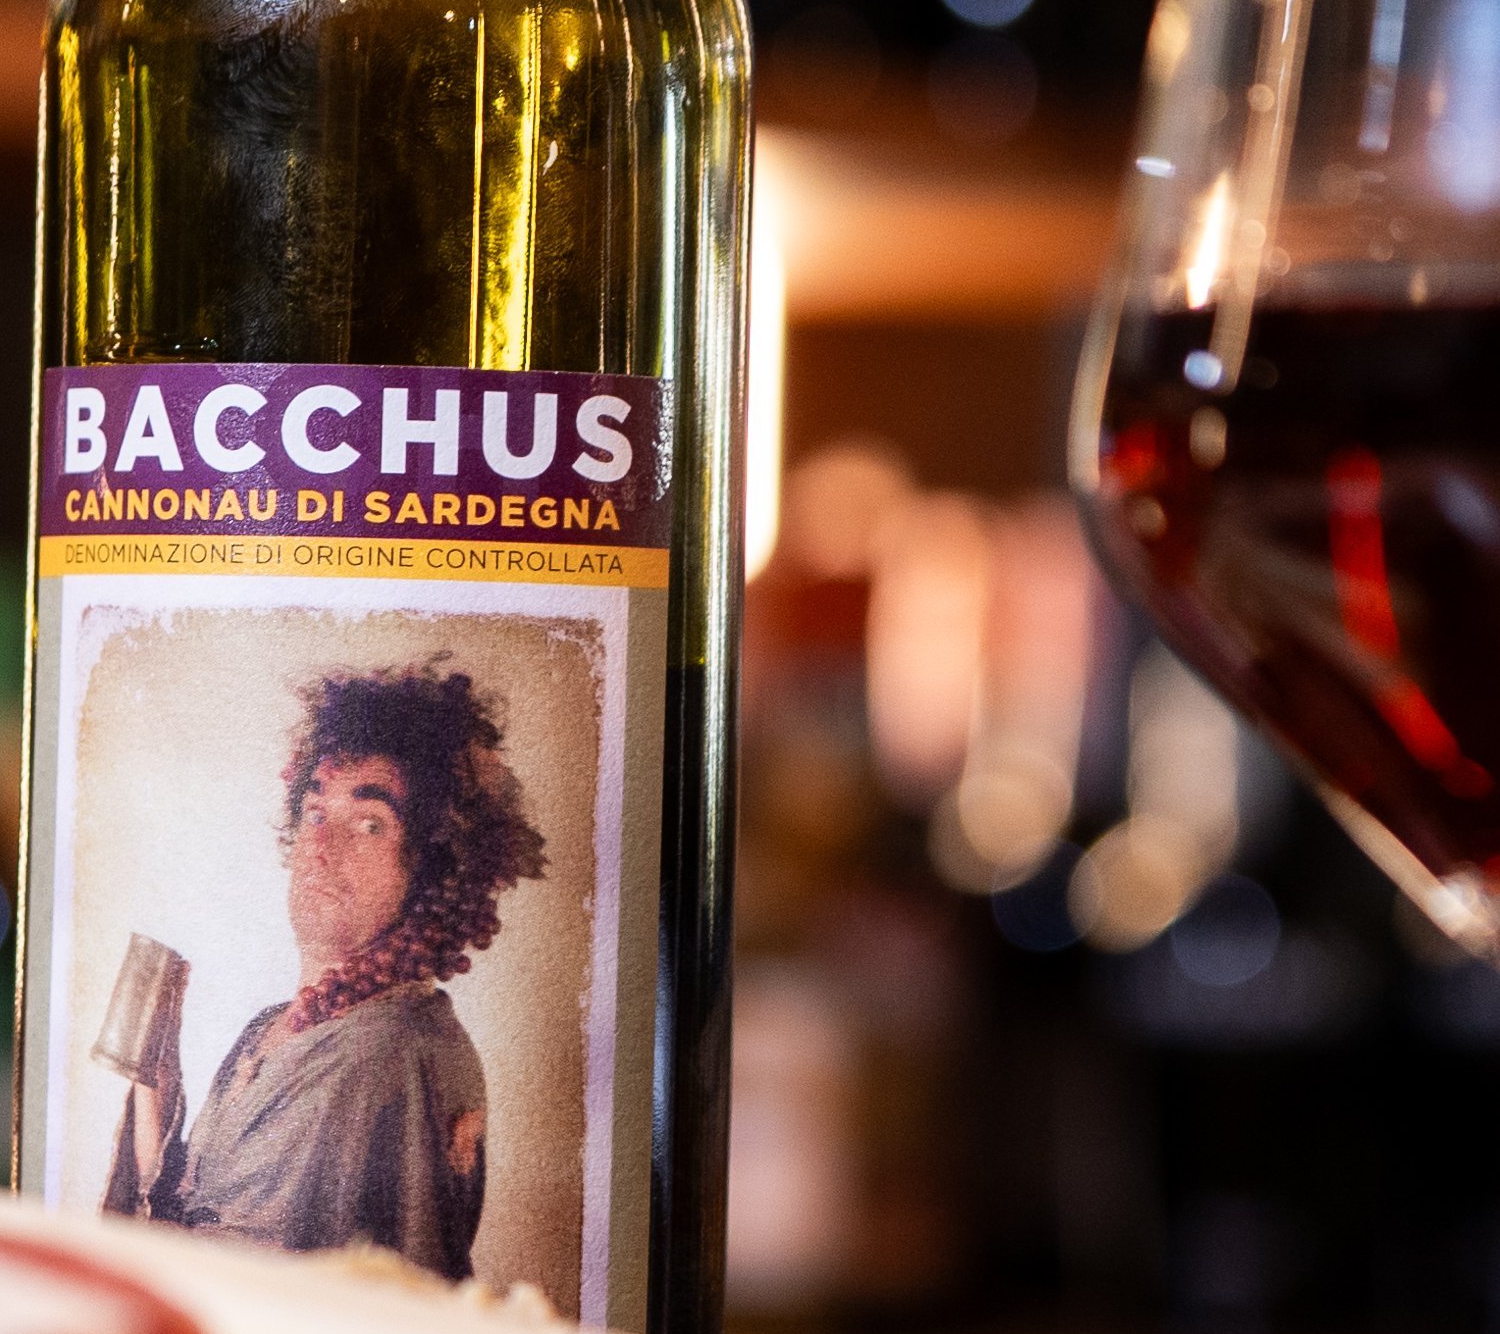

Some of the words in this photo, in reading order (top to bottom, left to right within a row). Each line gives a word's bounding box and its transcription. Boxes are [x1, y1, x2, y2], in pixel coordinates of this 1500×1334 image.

[64, 383, 634, 483] BACCHUS
[64, 488, 278, 522] CANNONAU
[296, 489, 344, 523] DI
[363, 490, 621, 531] SARDEGNA
[64, 543, 244, 565] DENOMINAZIONE
[255, 544, 282, 565] DI
[293, 544, 415, 568] ORIGINE
[426, 547, 624, 575] CONTROLLATA
